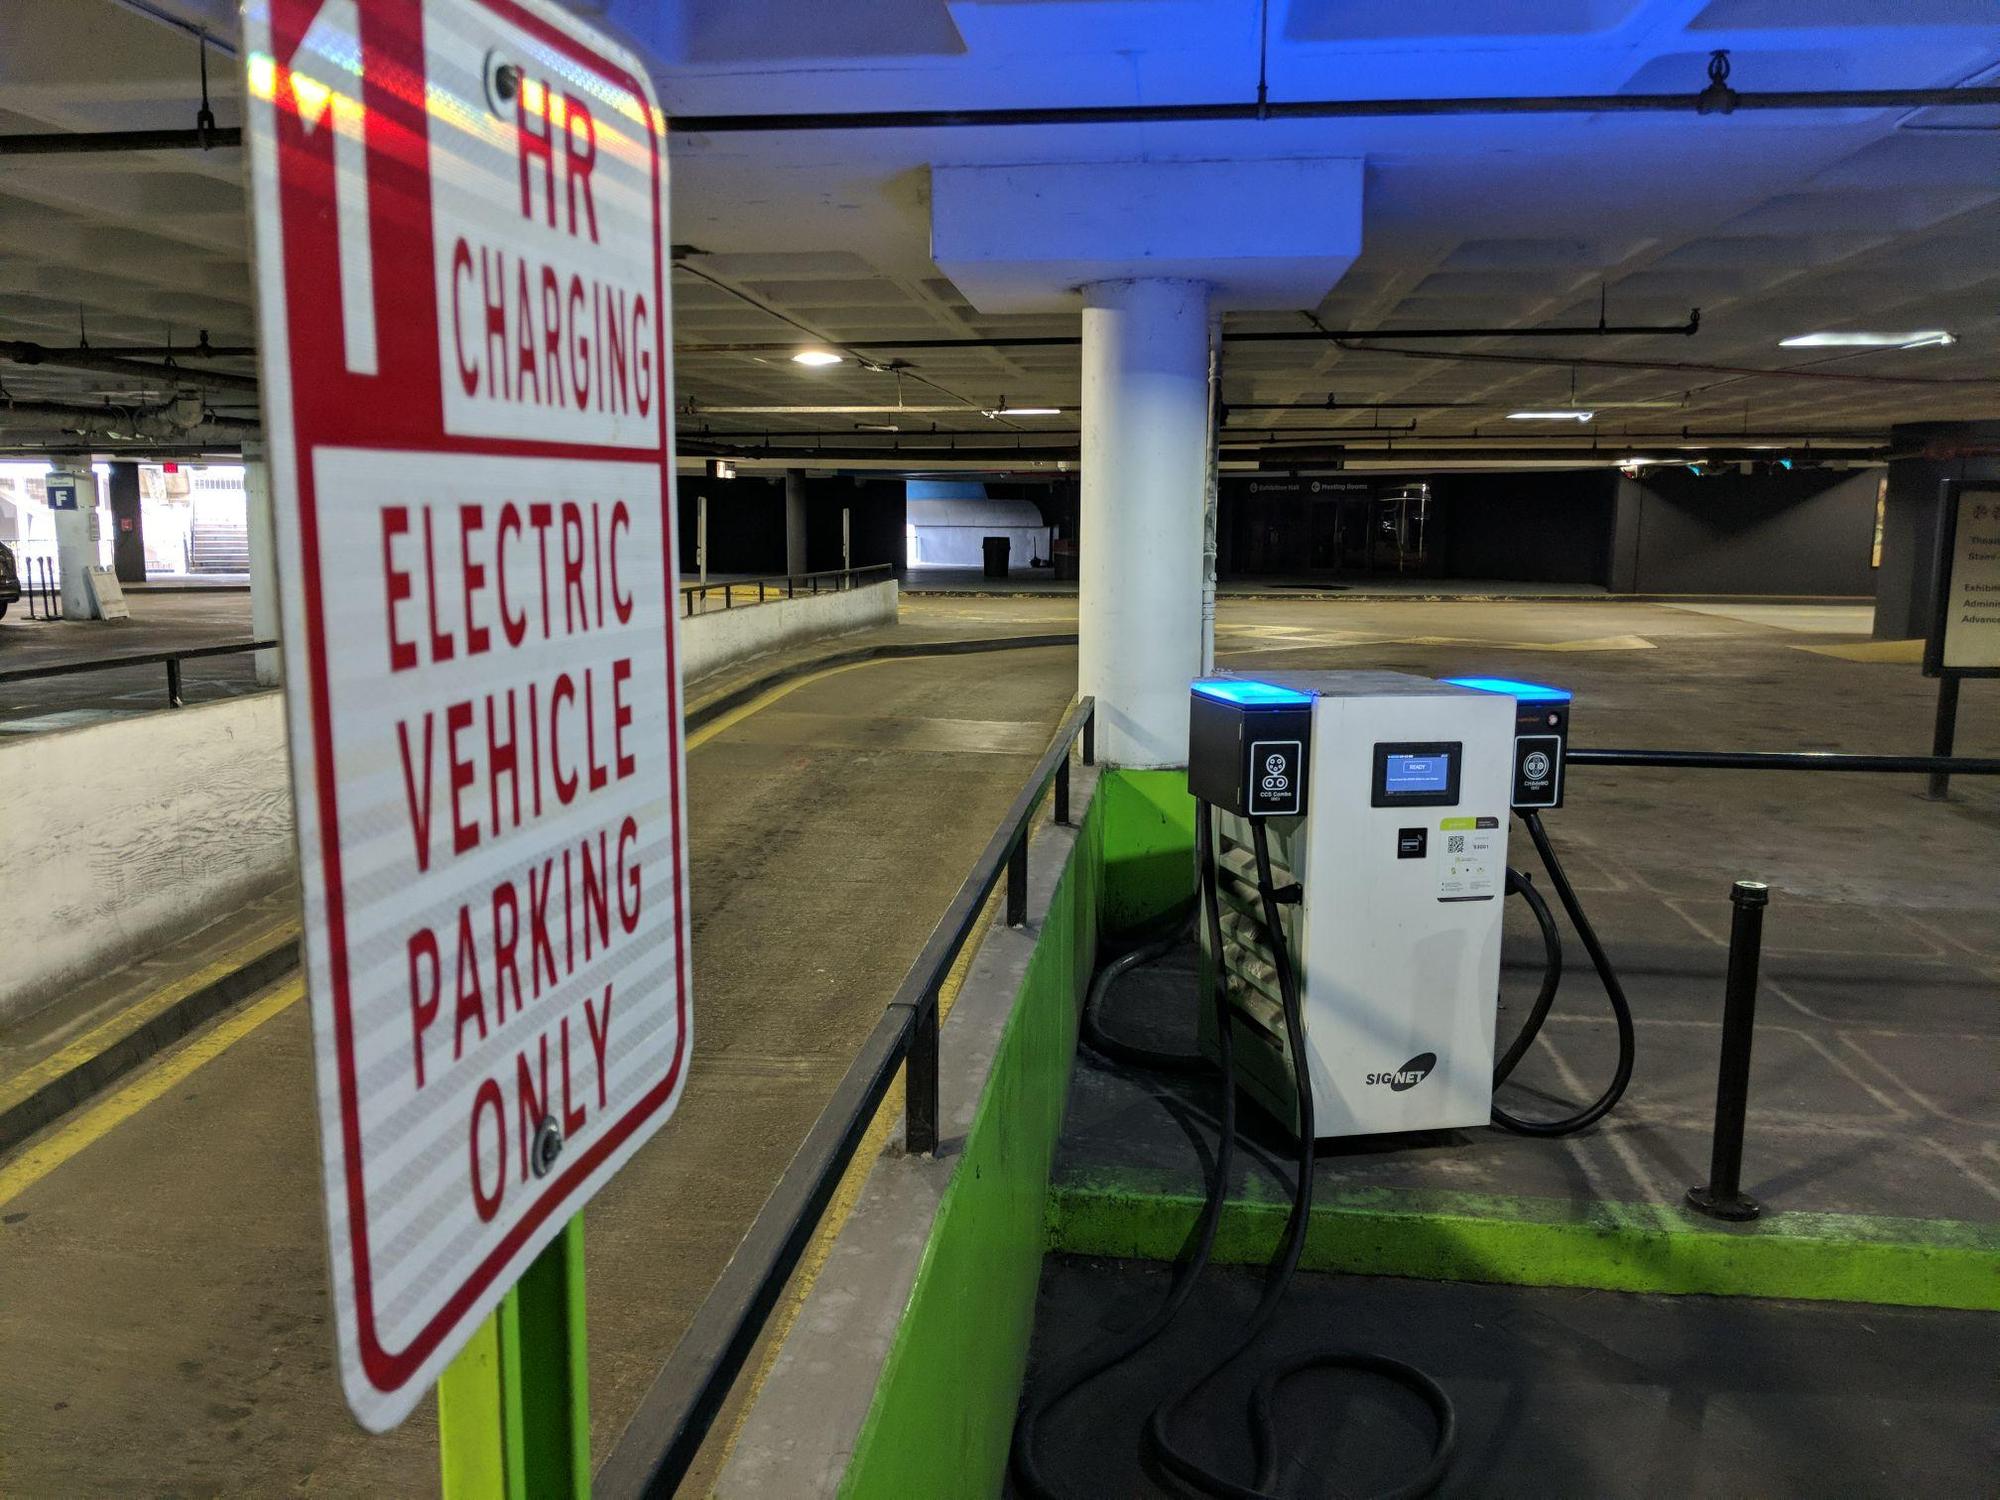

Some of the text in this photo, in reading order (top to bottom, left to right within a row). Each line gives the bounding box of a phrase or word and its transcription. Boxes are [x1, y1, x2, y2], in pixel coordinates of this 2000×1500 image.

[289, 0, 599, 377] 1 HR
[453, 236, 651, 418] CHARGING
[55, 490, 68, 507] F
[380, 500, 634, 673] ELECTRIC
[396, 657, 636, 873] VEHICLE
[408, 815, 642, 1090] PARKING
[469, 983, 613, 1224] ONLY
[1365, 1070, 1426, 1086] SIGNET
